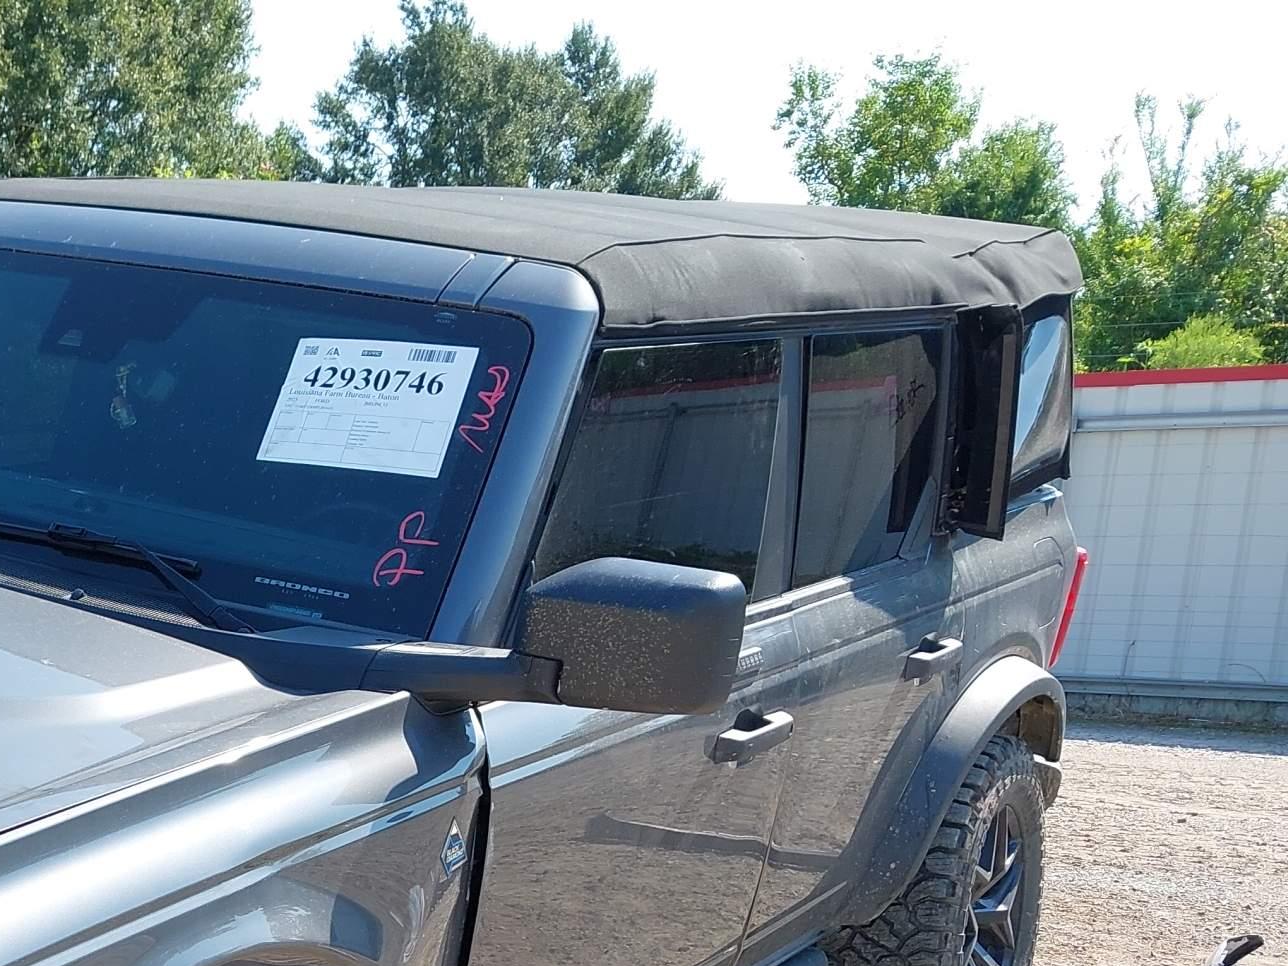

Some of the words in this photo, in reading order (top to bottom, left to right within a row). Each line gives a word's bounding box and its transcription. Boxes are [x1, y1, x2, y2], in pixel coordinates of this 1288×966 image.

[303, 365, 447, 396] 42930746
[289, 387, 323, 397] Louisiana
[324, 389, 343, 398] Farm
[344, 390, 371, 400] Bureau
[378, 393, 400, 401] Baton
[254, 576, 350, 599] BRONCO
